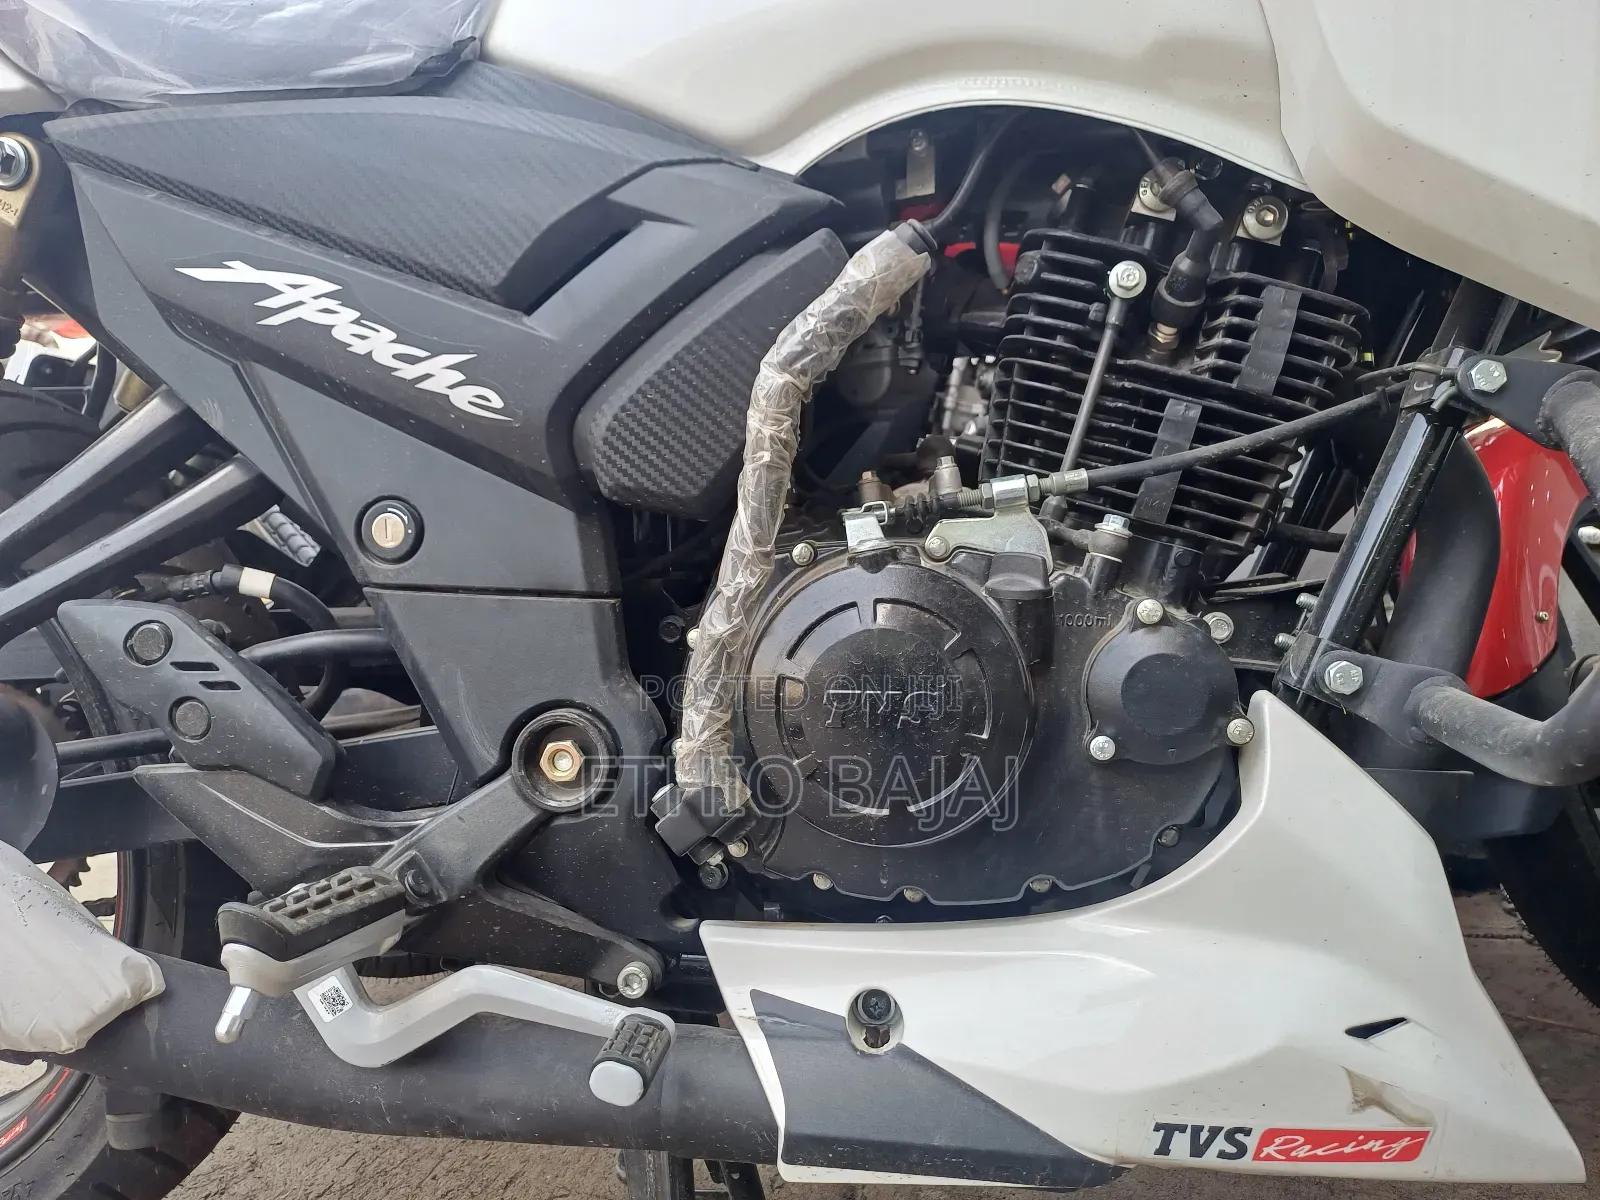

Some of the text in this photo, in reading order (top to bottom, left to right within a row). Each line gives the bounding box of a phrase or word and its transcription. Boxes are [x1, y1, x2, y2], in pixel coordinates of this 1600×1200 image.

[175, 260, 514, 421] Apache
[1152, 1122, 1425, 1160] TVS Racing
